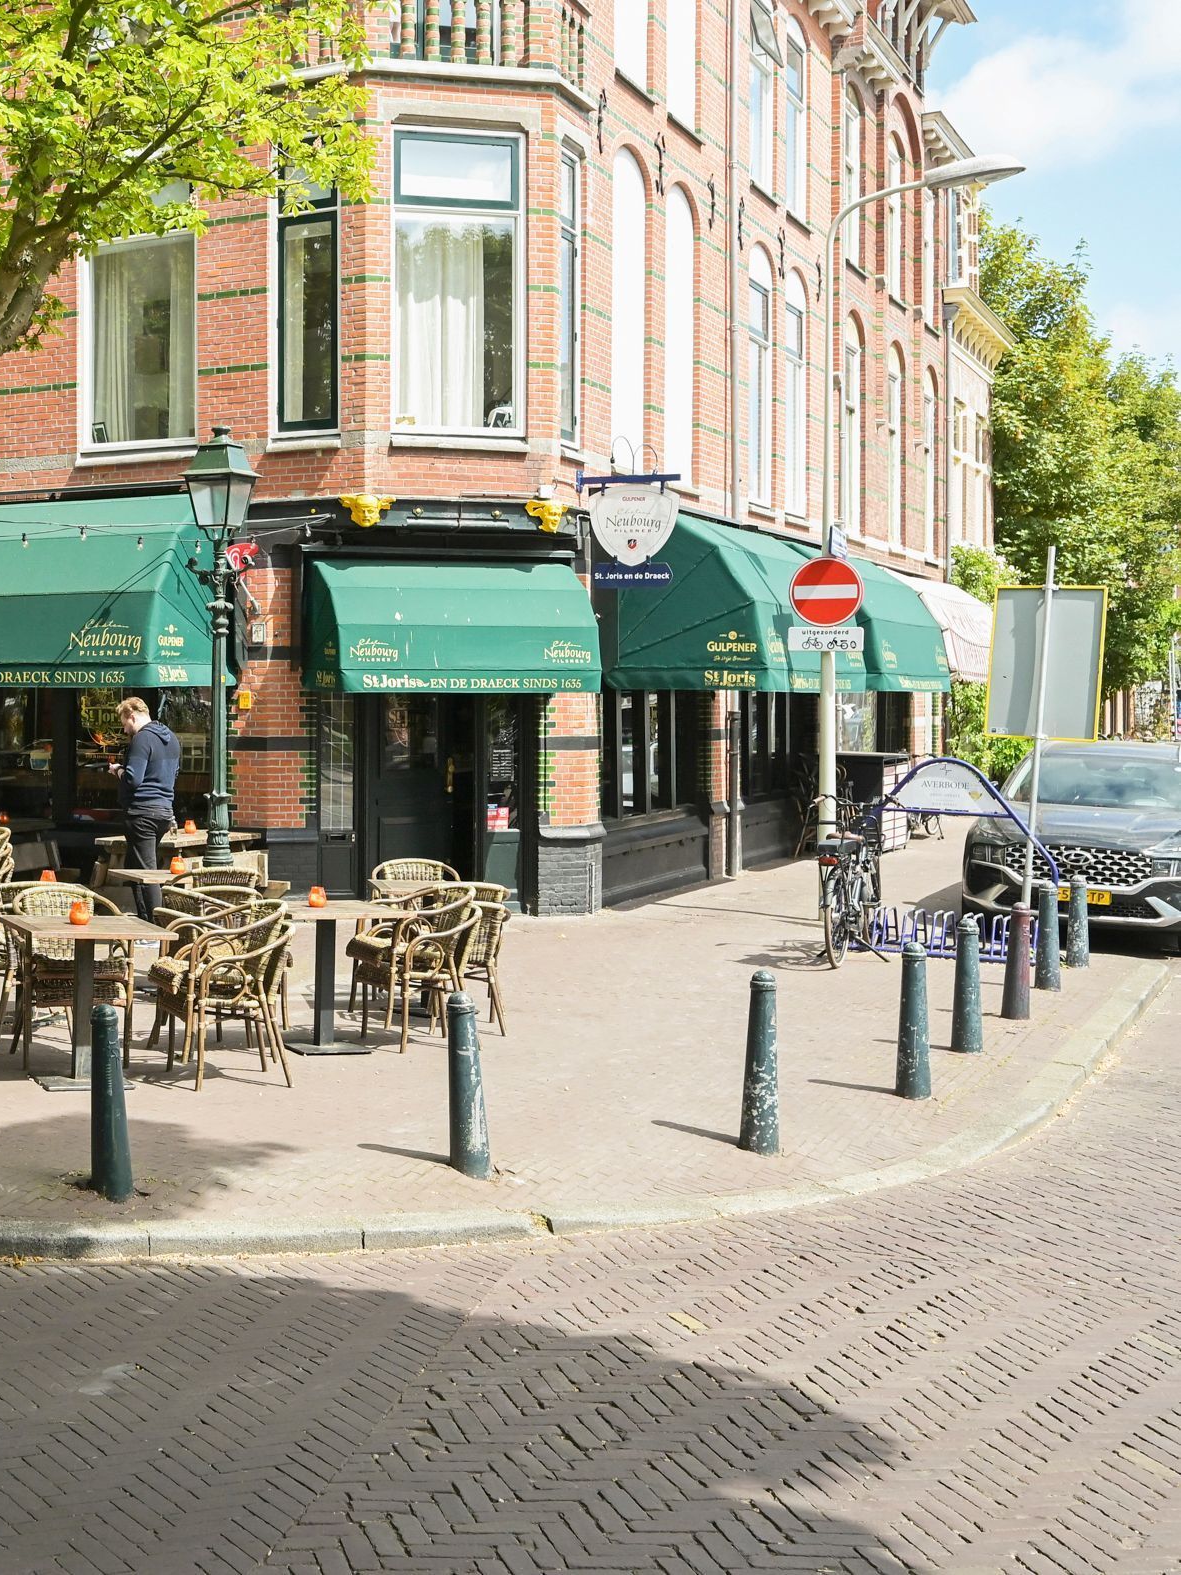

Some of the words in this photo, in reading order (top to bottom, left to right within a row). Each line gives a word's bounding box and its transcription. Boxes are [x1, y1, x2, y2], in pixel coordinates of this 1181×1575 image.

[605, 514, 662, 533] Neubourg
[594, 572, 604, 580] St.
[606, 572, 623, 580] Joris
[634, 572, 643, 580] de
[644, 572, 670, 580] Draeck
[67, 628, 142, 656] Neubourg
[706, 640, 757, 653] GULPENER
[349, 644, 399, 662] Neubourg
[544, 646, 591, 664] Neubourg
[54, 671, 96, 683] SINDS
[100, 671, 125, 683] 1635
[430, 678, 447, 689] EN
[450, 678, 468, 689] DE
[470, 678, 520, 689] DRAECK
[523, 678, 558, 689] SINDS
[561, 678, 581, 689] 1635
[721, 670, 756, 686] Joris
[921, 780, 970, 790] AVERBODE
